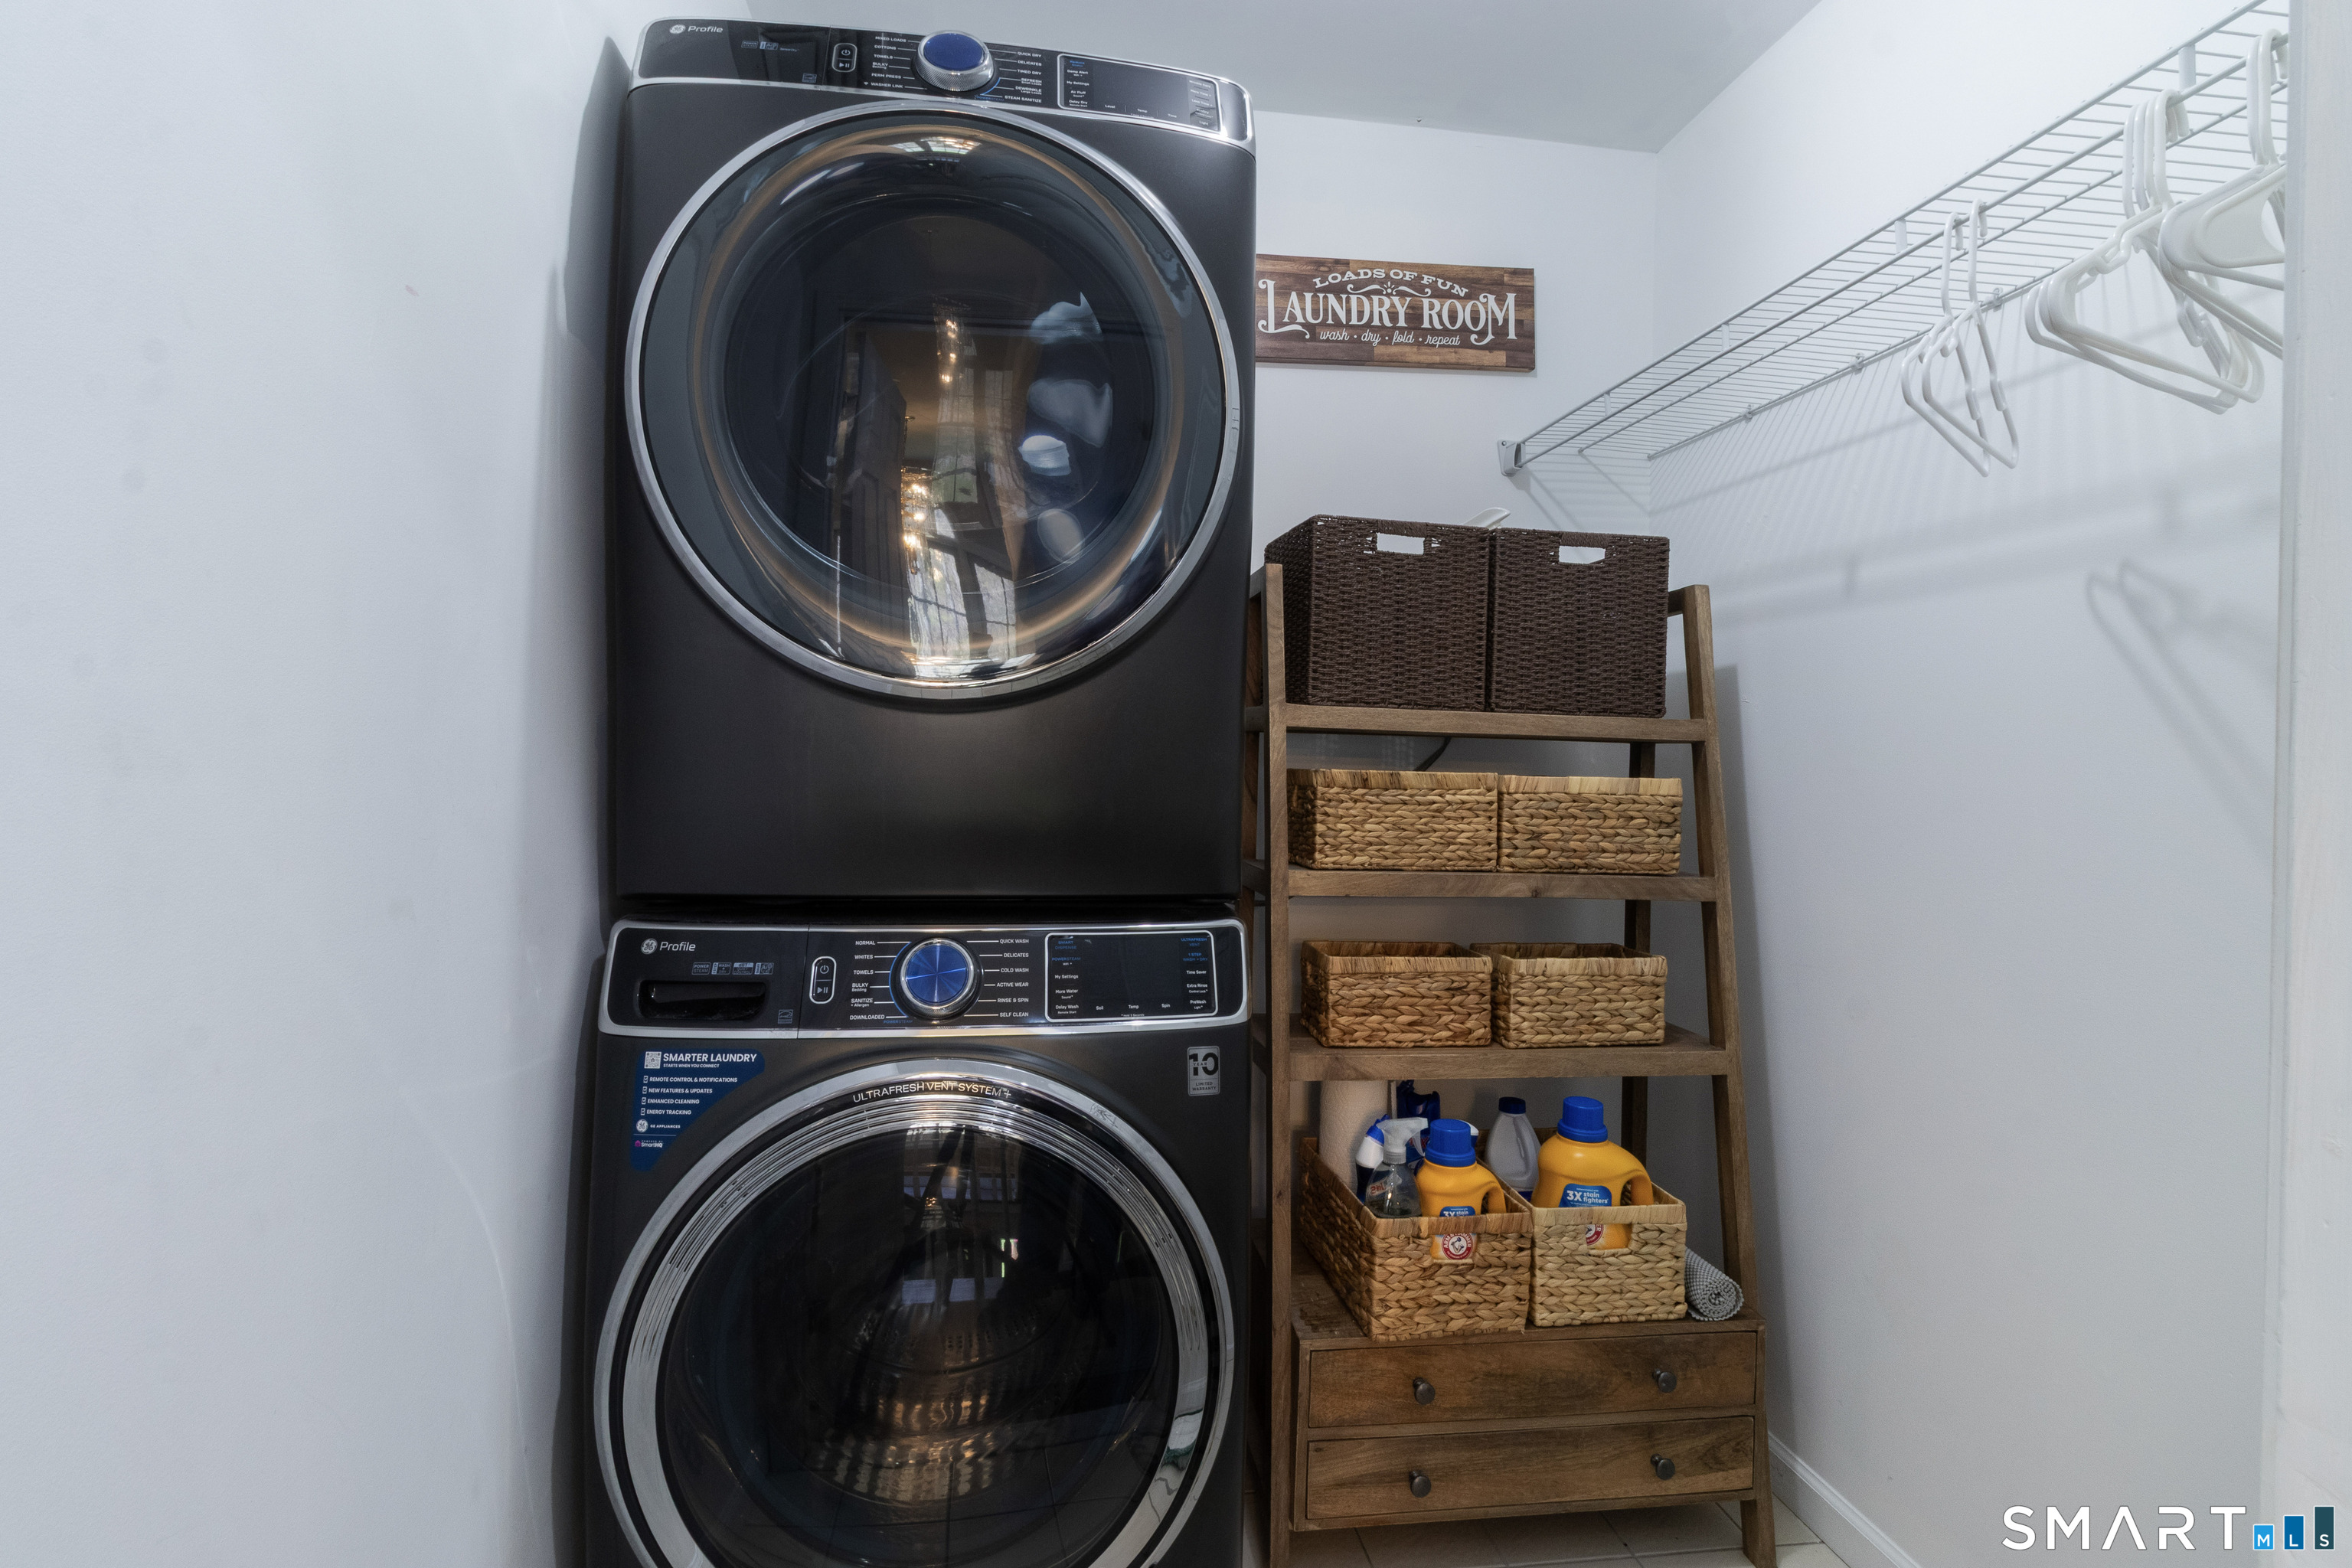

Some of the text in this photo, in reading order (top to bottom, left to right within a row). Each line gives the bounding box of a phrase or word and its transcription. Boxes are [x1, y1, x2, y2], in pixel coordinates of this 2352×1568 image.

[1312, 268, 1469, 298] LOADS OF FUN
[1257, 279, 1518, 345] LAUNDRY ROOM
[1319, 329, 1461, 348] wash dry fold repeat
[660, 942, 696, 951] Profile
[663, 1053, 757, 1062] SMARTER LAUNDRY
[1189, 1052, 1218, 1076] 10
[853, 1082, 1011, 1102] ULTRAFRESH VENT SYSTEM +
[1566, 1191, 1583, 1201] 3X
